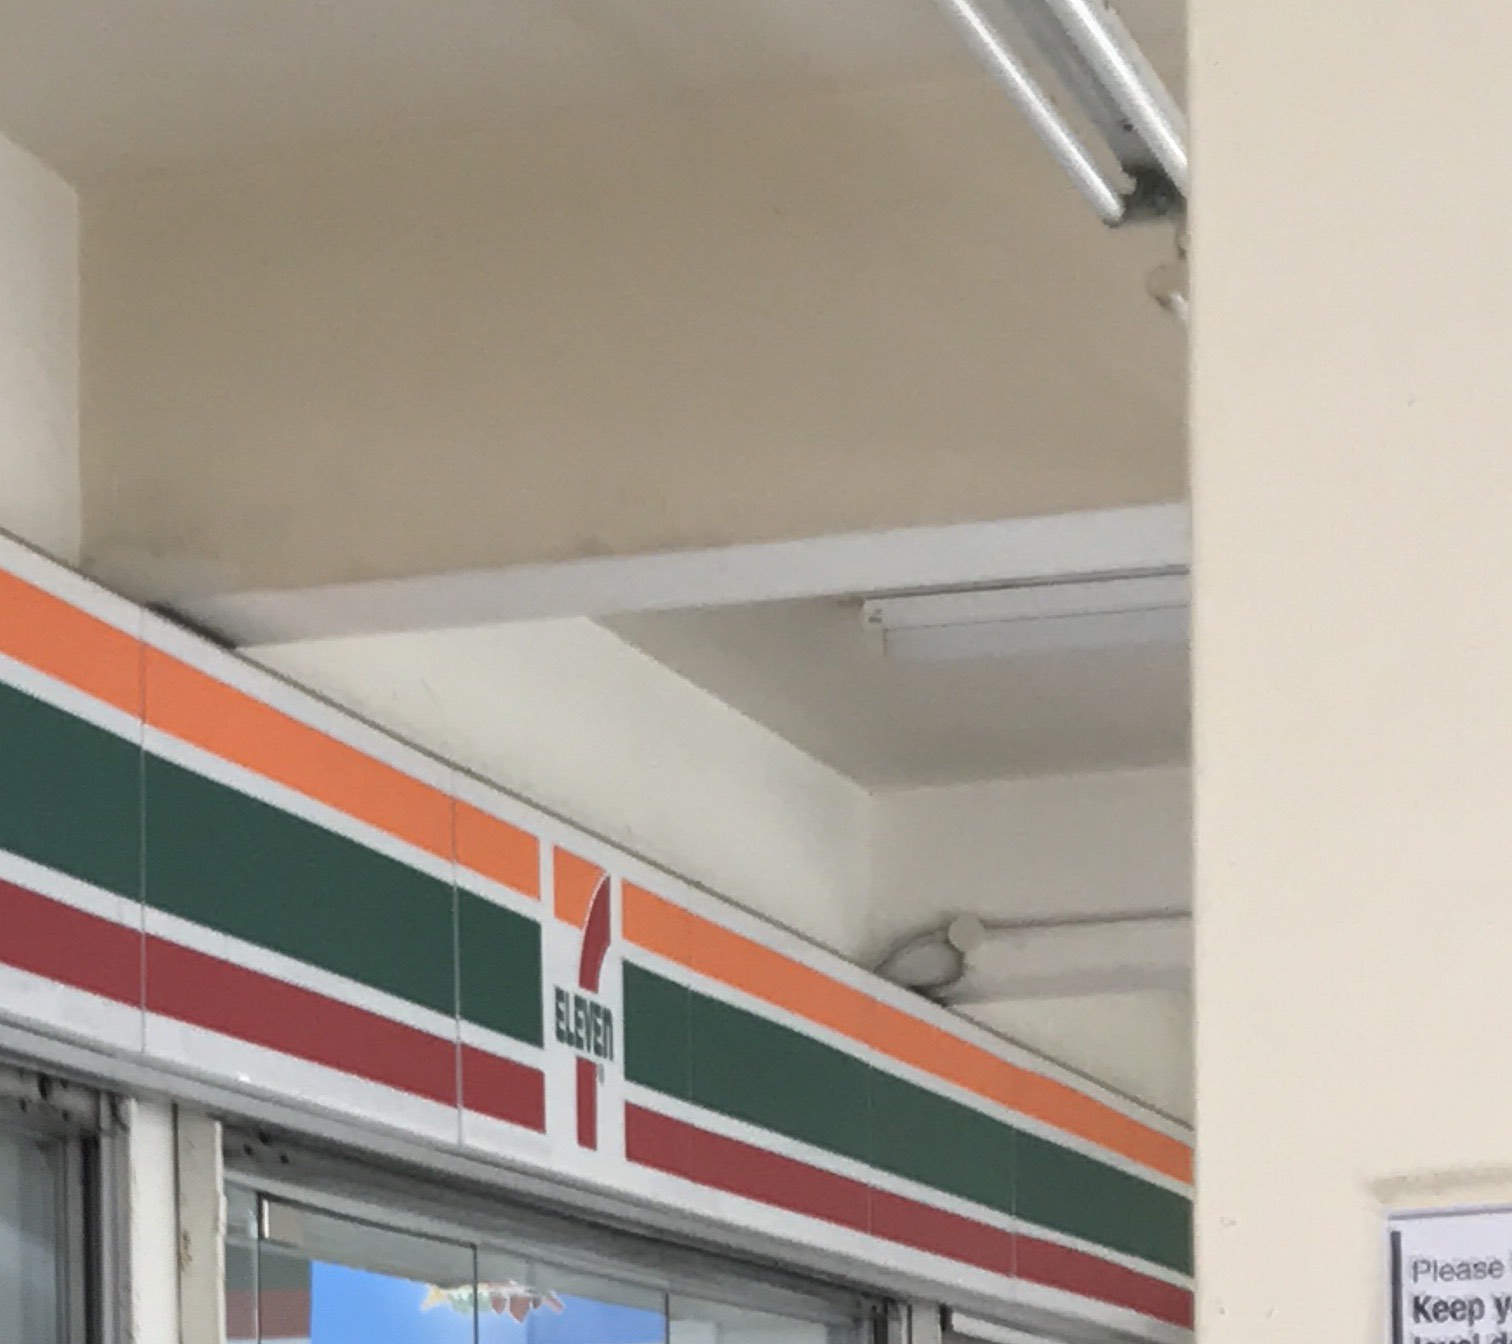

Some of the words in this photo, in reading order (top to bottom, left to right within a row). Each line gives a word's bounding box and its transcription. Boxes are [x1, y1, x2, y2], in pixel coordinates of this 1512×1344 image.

[1412, 1258, 1504, 1283] Please
[1412, 1295, 1485, 1327] Keep
[1493, 1295, 1512, 1325] y
